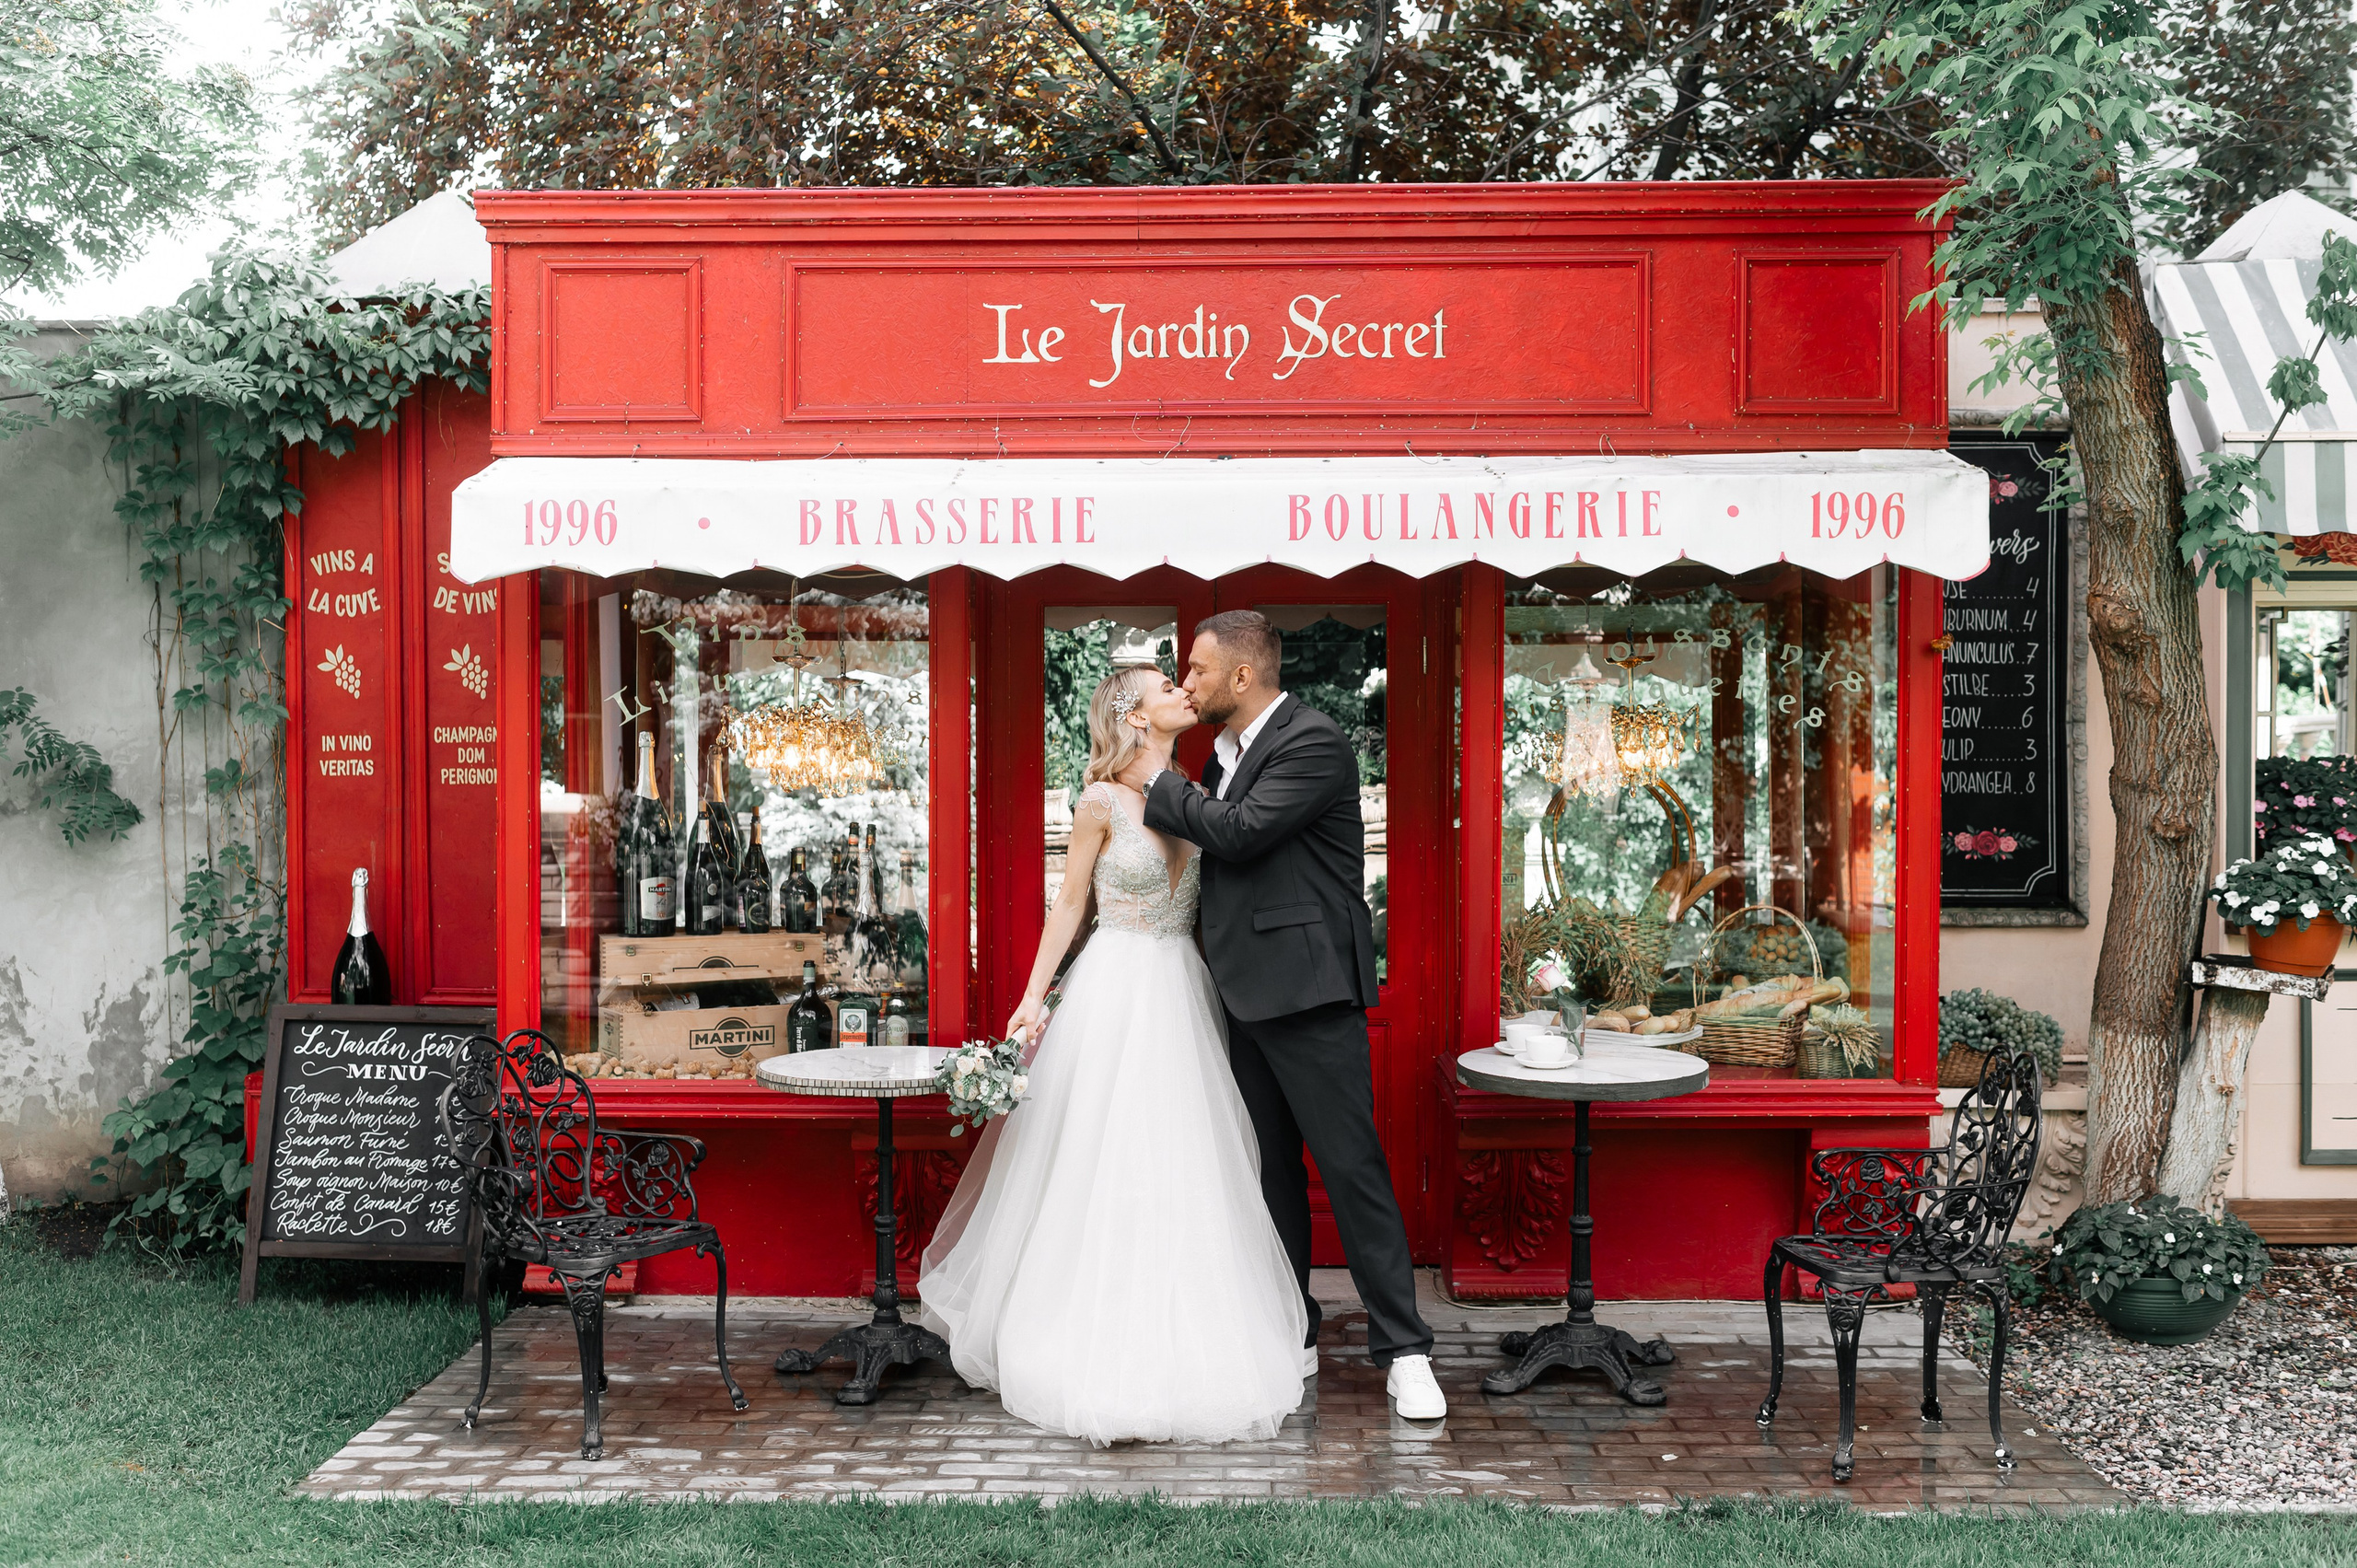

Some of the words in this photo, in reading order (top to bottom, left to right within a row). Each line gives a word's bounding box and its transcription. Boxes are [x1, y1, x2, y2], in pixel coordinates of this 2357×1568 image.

[982, 303, 1065, 363] Le
[1089, 299, 1249, 387] Jardin
[1272, 294, 1447, 380] Secret
[523, 498, 618, 546] 1996
[798, 496, 1096, 545] BRASSERIE
[1288, 490, 1661, 540] BOULANGERIE
[1810, 492, 1906, 539] 1996
[310, 550, 355, 575] VINS
[360, 552, 374, 575] A
[1943, 579, 1968, 599] OSE
[2026, 576, 2040, 599] 4
[308, 588, 330, 614] LA
[334, 587, 381, 617] CUVE
[434, 587, 459, 614] DE
[462, 587, 496, 615] VIN
[1943, 608, 2008, 632] IBURNUM
[2023, 610, 2038, 633] 4
[640, 614, 807, 656] Vins
[1532, 627, 1866, 698] Coissants
[1942, 641, 2014, 664] ANUNCULUS
[2026, 642, 2039, 665] 7
[1943, 673, 1990, 697] STILBE
[2023, 674, 2035, 697] 3
[1942, 706, 1981, 728] EONY
[2021, 705, 2035, 728] 6
[321, 735, 335, 751] IN
[339, 735, 372, 751] VINO
[434, 726, 497, 743] CHAMPAGN
[458, 748, 485, 763] DOM
[1942, 738, 1975, 761] ULIP
[2025, 738, 2038, 761] 3
[319, 759, 374, 776] VERITAS
[1941, 771, 2012, 795] YDRANGEA
[2026, 771, 2036, 794] 8
[294, 1025, 327, 1055] Le
[325, 1027, 410, 1061] Jardin
[411, 1032, 472, 1064] Secrt
[695, 1029, 770, 1045] MARTINI
[346, 1063, 428, 1081] MENU
[284, 1084, 342, 1112] Croque
[344, 1085, 420, 1108] Madame
[284, 1106, 338, 1133] Croque
[340, 1108, 421, 1132] Monsieur
[278, 1127, 354, 1150] Saumon
[360, 1131, 410, 1150] Fumé
[274, 1147, 342, 1169] Jambon
[343, 1156, 366, 1167] au
[368, 1150, 429, 1175] Fromage
[432, 1154, 460, 1169] 17€
[273, 1167, 312, 1195] Soup
[316, 1171, 368, 1195] oignon
[368, 1170, 433, 1193] Maison
[435, 1176, 464, 1194] 10€
[270, 1190, 323, 1216] Confit
[325, 1193, 346, 1212] de
[354, 1192, 424, 1214] Canard
[428, 1199, 460, 1216] 15€
[277, 1211, 348, 1237] Raclette
[424, 1216, 456, 1236] 18€
